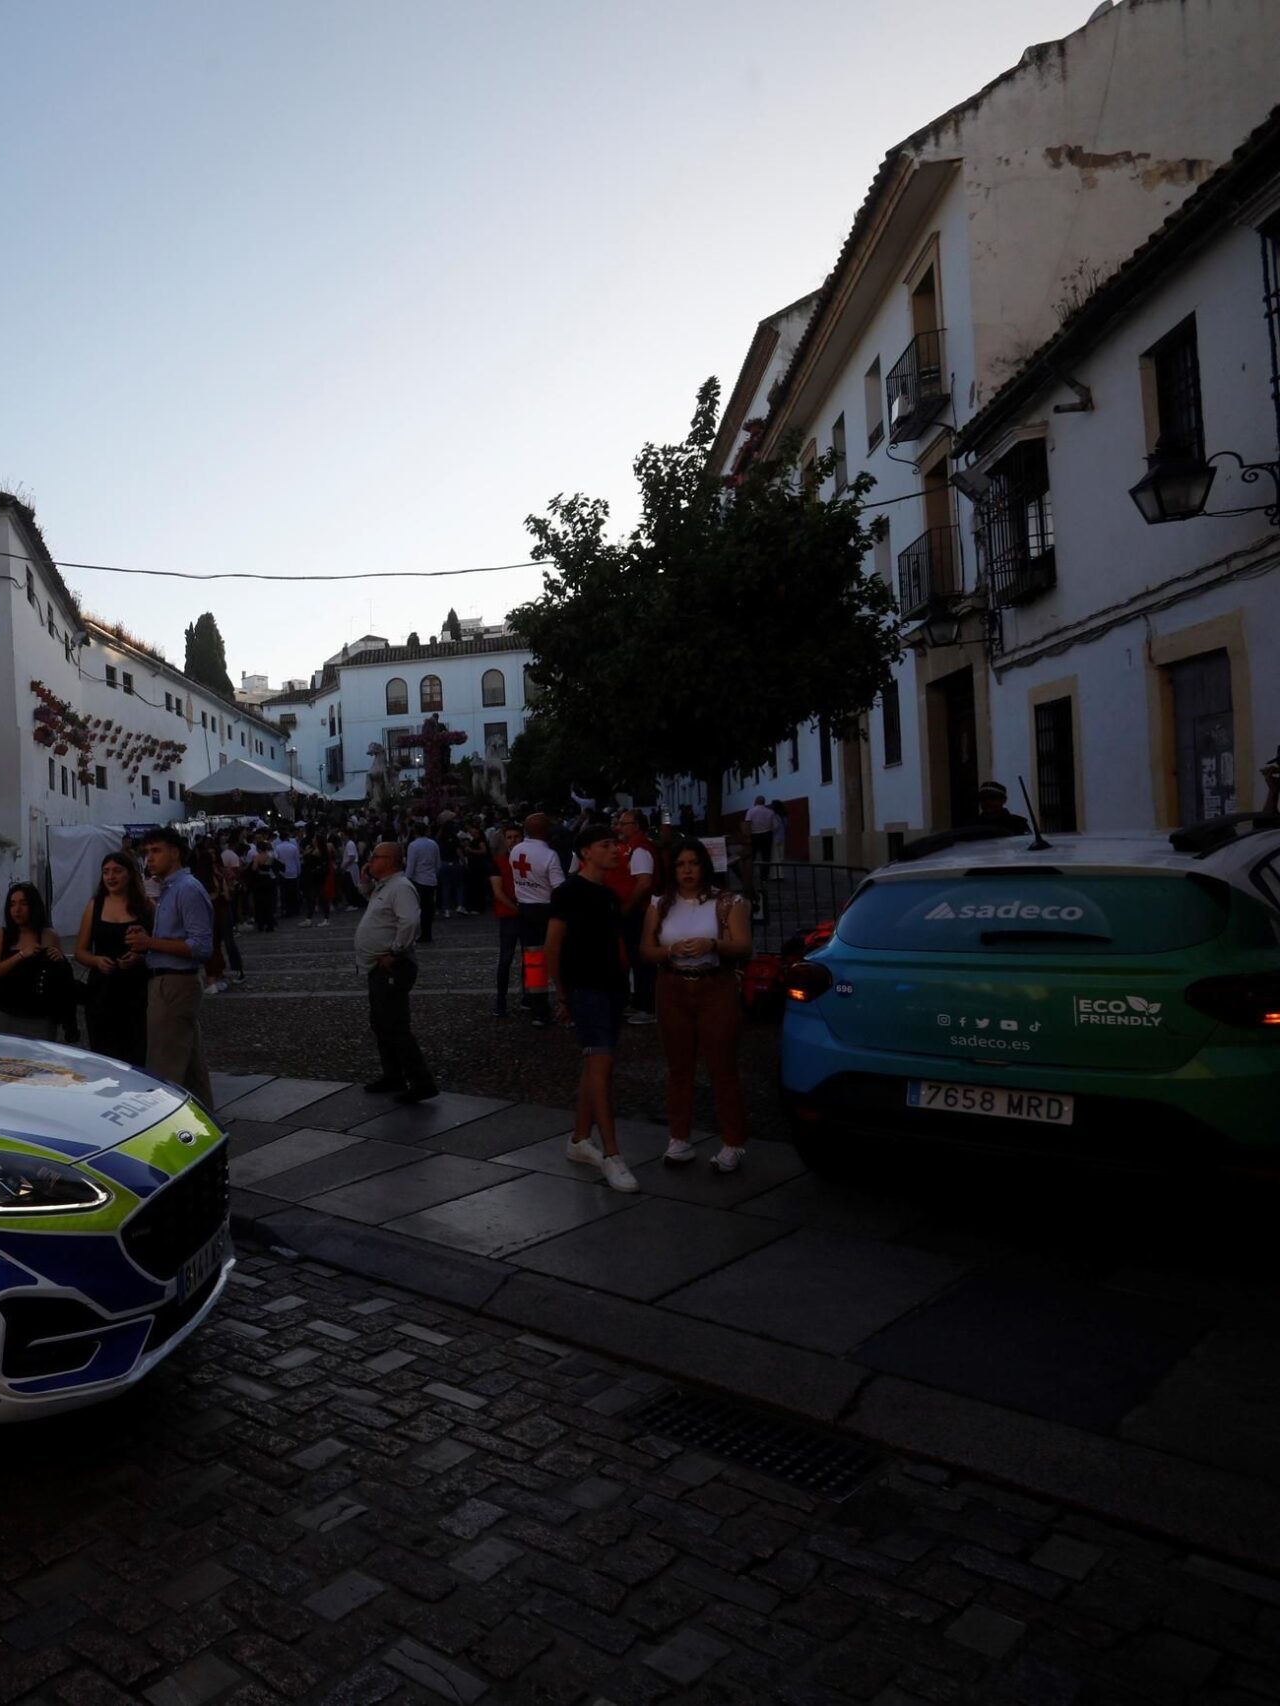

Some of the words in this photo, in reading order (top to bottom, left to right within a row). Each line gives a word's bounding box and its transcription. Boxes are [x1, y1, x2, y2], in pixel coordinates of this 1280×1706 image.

[958, 900, 1084, 921] sadeco
[1079, 999, 1127, 1014] ECO
[1080, 1014, 1163, 1028] FRIENDLY
[950, 1034, 1031, 1051] sadeco.es
[926, 1084, 995, 1112] 7658
[1007, 1093, 1063, 1121] MRD
